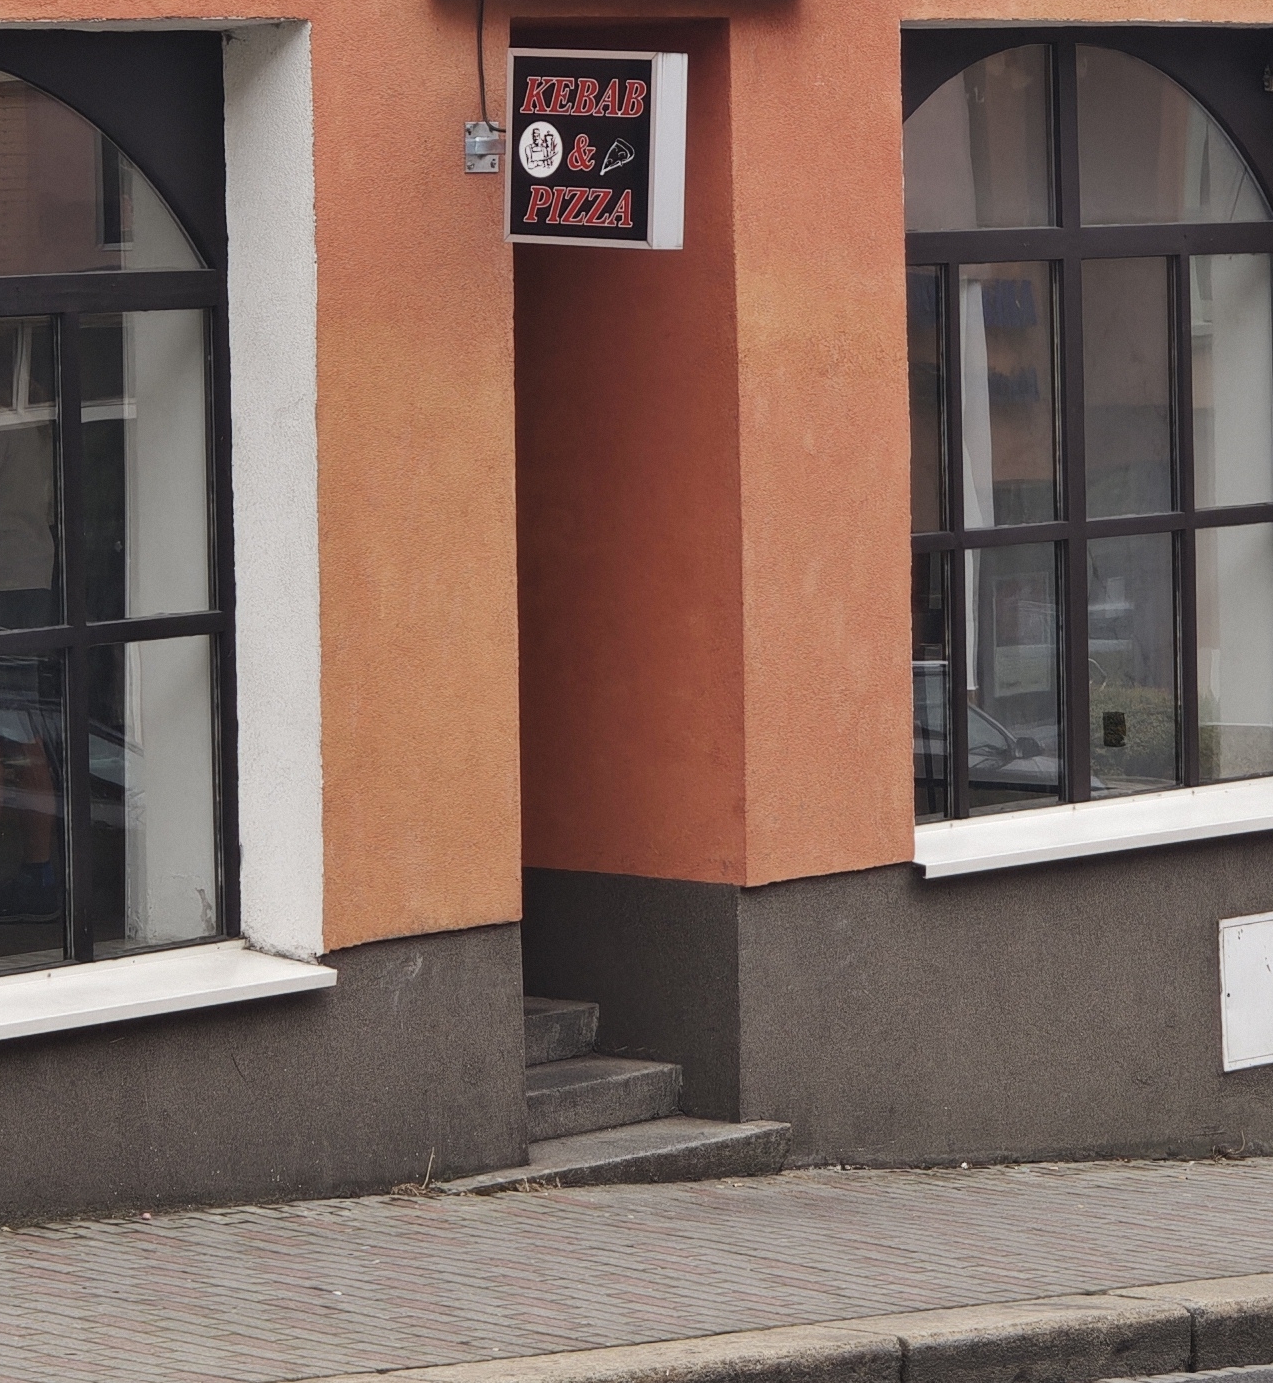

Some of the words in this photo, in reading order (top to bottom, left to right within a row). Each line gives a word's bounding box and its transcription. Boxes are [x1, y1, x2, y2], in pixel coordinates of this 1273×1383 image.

[520, 76, 647, 118] KEBAB
[567, 133, 597, 172] &
[523, 185, 633, 228] PIZZA
